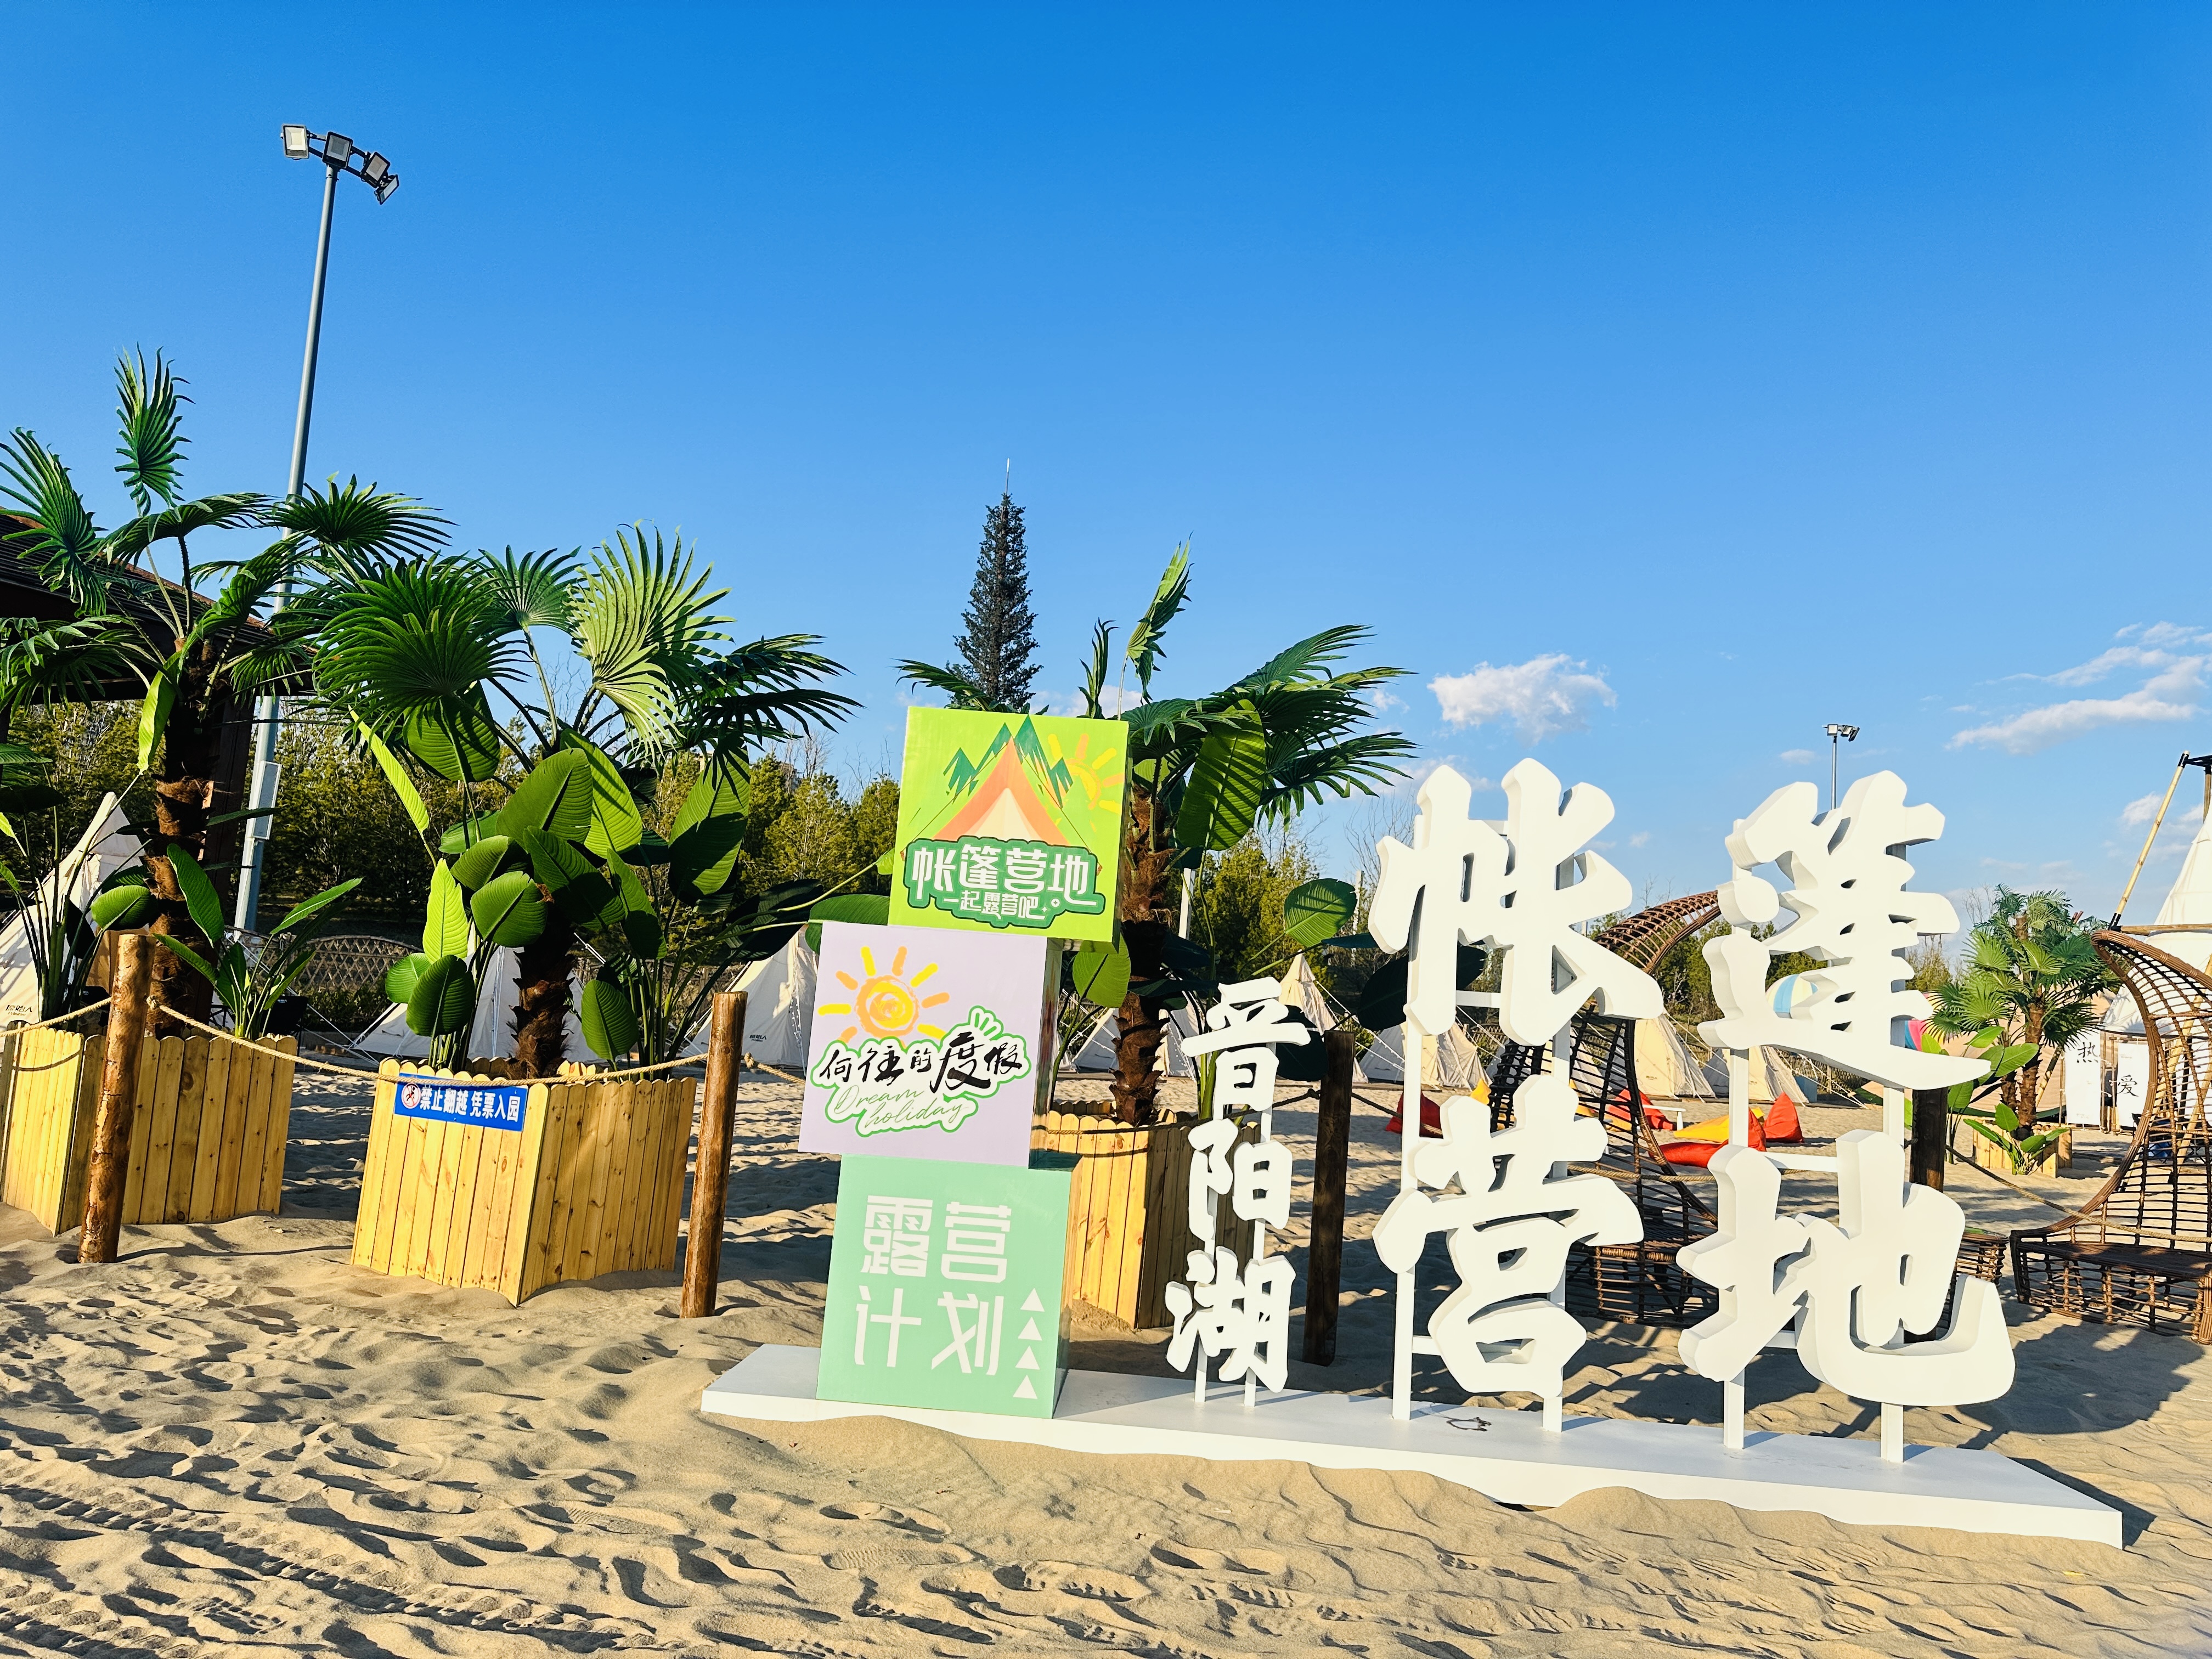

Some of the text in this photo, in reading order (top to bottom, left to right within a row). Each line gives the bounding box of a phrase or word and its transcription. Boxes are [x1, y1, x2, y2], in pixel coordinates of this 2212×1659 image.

[912, 844, 1097, 906] 帐篷营地
[943, 890, 1045, 920] 一起露营吧
[1368, 758, 1990, 1090] 帐篷
[2076, 1041, 2100, 1063] 热
[420, 1085, 521, 1122] 禁止翻越 凭票入园
[834, 1085, 924, 1114] Dream
[2117, 1074, 2139, 1097] 爱
[865, 1098, 969, 1128] holiday
[1165, 976, 1311, 1393] 晋阳湖
[860, 1195, 1012, 1283] 露营
[1372, 1074, 2016, 1406] 营地
[854, 1285, 1005, 1375] 计划
